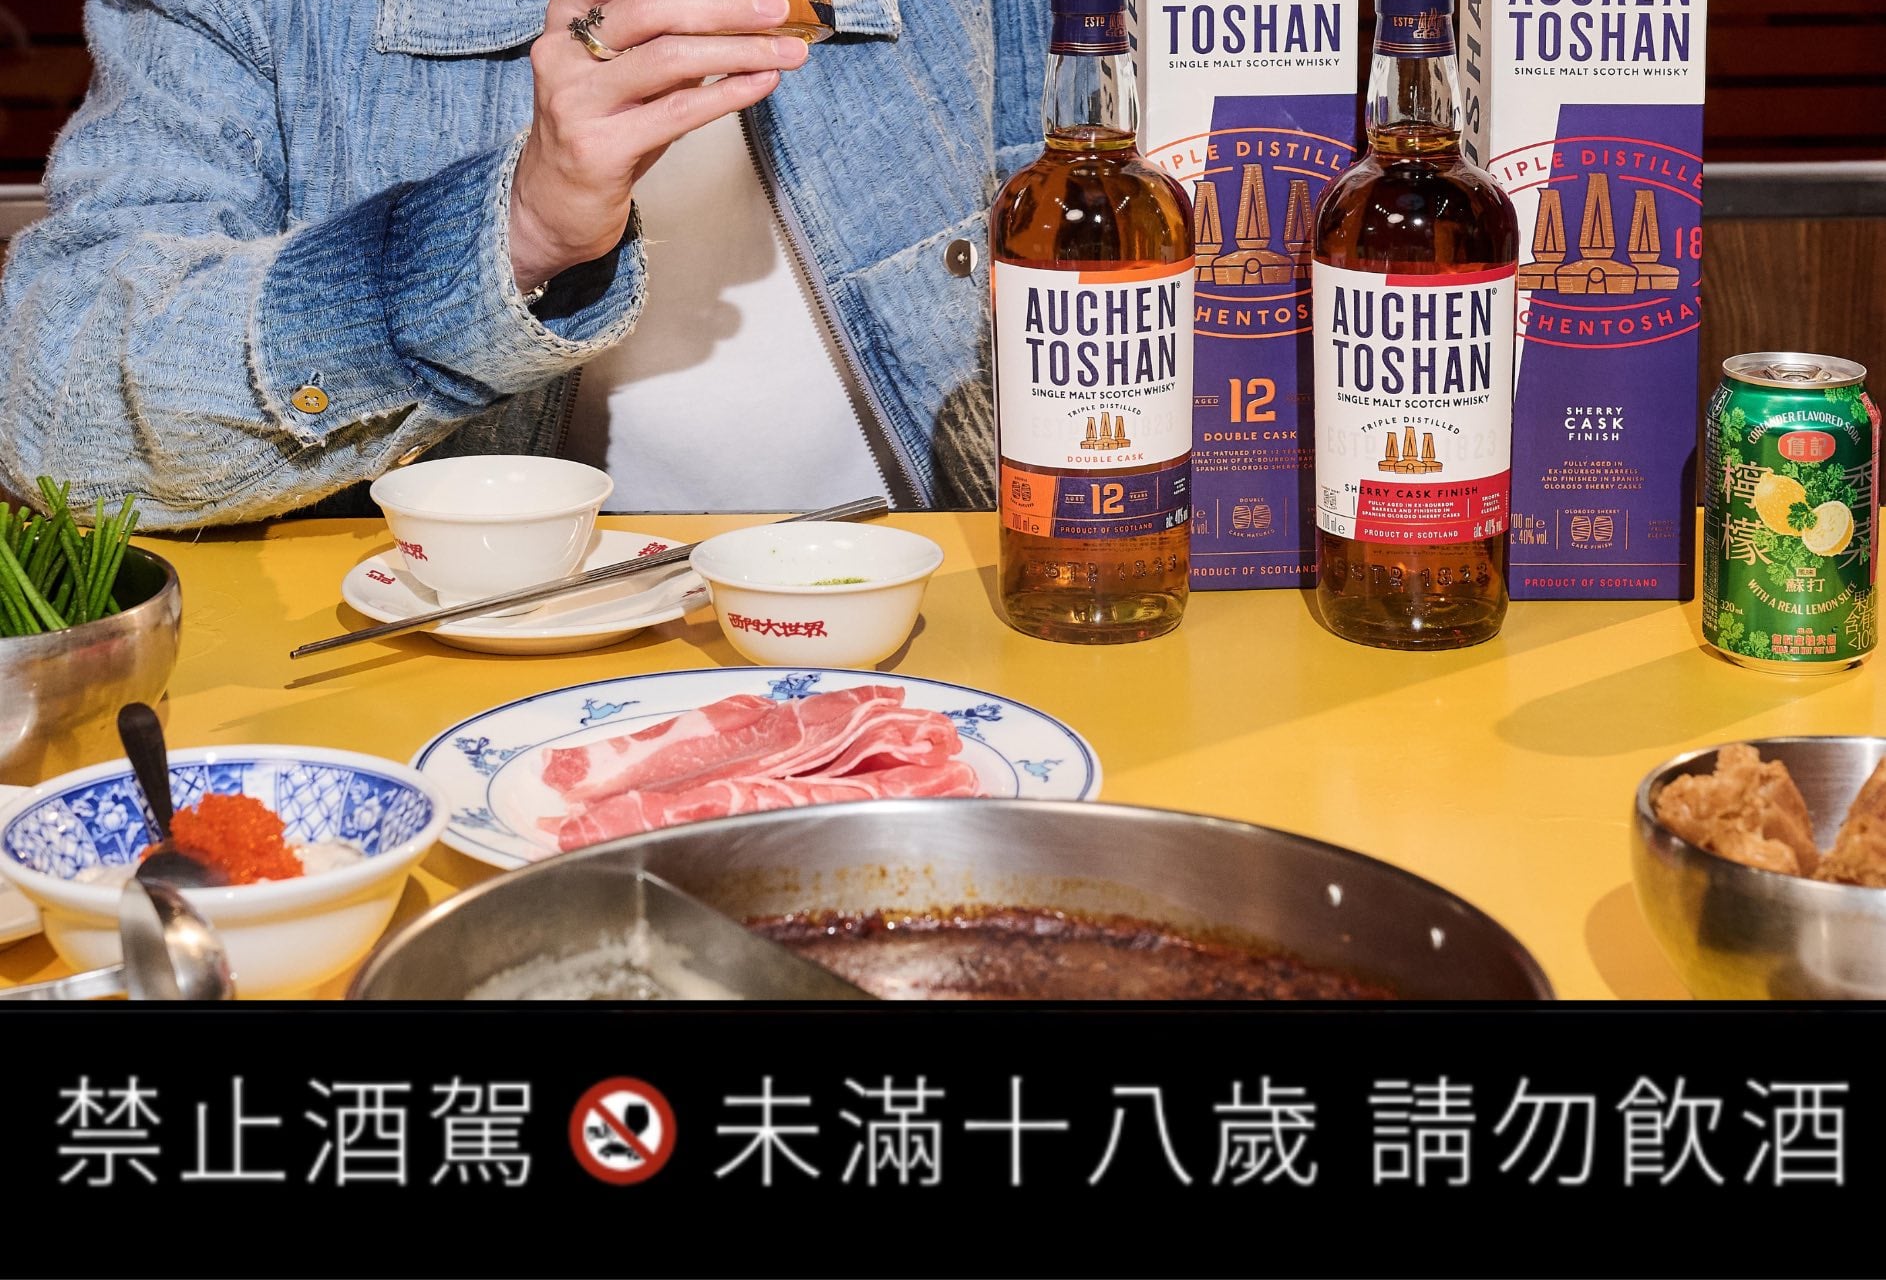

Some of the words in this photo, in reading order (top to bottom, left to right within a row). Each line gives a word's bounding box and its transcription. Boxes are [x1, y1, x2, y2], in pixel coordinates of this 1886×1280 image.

[1162, 3, 1341, 55] TOSHAN
[1508, 11, 1690, 62] TOSHAN
[1168, 60, 1209, 69] SINGLE
[1213, 59, 1242, 68] MALT
[1246, 59, 1292, 68] SCOTCH
[1296, 58, 1341, 67] WHISKY
[1514, 67, 1556, 76] SINGLE
[1559, 67, 1589, 76] MALT
[1593, 67, 1639, 76] SCOTCH
[1643, 67, 1689, 76] WHISKY
[1160, 144, 1220, 170] IPLE
[1236, 141, 1355, 170] DISTILL
[1503, 152, 1564, 180] IPLE
[1581, 149, 1703, 190] DISTILLE
[1675, 226, 1703, 259] 18
[1025, 282, 1177, 336] AUCHEN
[1195, 303, 1308, 326] HENTOS
[1332, 285, 1492, 342] AUCHEN
[1519, 296, 1702, 336] CHENTOSHA
[1025, 332, 1177, 387] TOSHAN
[1332, 338, 1491, 396] TOSHAN
[1031, 388, 1066, 400] SINGLE
[1069, 390, 1097, 400] MALT
[1100, 388, 1141, 399] SCOTCH
[1144, 382, 1176, 396] WHISKY
[1228, 378, 1276, 423] 12
[1337, 392, 1370, 406] SINGLE
[1373, 398, 1401, 408] MALT
[1405, 399, 1450, 409] SCOTCH
[1452, 394, 1490, 407] WHISKY
[1067, 404, 1096, 418] TRIPLE
[1100, 403, 1142, 416] DISTILLED
[1566, 407, 1624, 416] SHERRY
[1361, 416, 1397, 433] TRIPLE
[1403, 416, 1461, 435] DISTILLED
[1564, 417, 1624, 430] CASK
[1747, 411, 1795, 445] CORIANDER
[1797, 410, 1844, 428] FLAVORED
[1844, 421, 1862, 446] SODA
[1204, 432, 1257, 442] DOUBLE
[1263, 431, 1298, 440] CASK
[1568, 433, 1620, 441] FINISH
[1067, 455, 1112, 463] DOUBLE
[1117, 453, 1145, 462] CASK
[1090, 483, 1125, 515] 12
[1344, 483, 1390, 497] SHERRY
[1396, 489, 1432, 499] CASK
[1437, 486, 1478, 498] FINISH
[1060, 526, 1098, 535] PRODUCT
[1101, 526, 1111, 534] OF
[1114, 523, 1153, 534] SCOTLAND
[1364, 528, 1400, 538] PRODUCT
[1403, 529, 1414, 538] OF
[1417, 530, 1459, 539] SCOTLAND
[1518, 530, 1535, 545] 40%
[1536, 531, 1549, 545] vol.
[1190, 567, 1237, 577] RODUCT
[1242, 566, 1255, 576] OF
[1260, 564, 1316, 575] SCOTLAND
[1524, 578, 1576, 587] PRODUCT
[1581, 578, 1595, 587] OF
[1600, 578, 1658, 587] SCOTLAND
[1747, 578, 1770, 602] WITH
[1768, 599, 1776, 608] A
[1777, 600, 1803, 615] REAL
[1806, 599, 1839, 615] LEMON
[1838, 580, 1859, 605] SLICE
[1720, 599, 1735, 613] 320
[727, 612, 828, 638] 西門大世界
